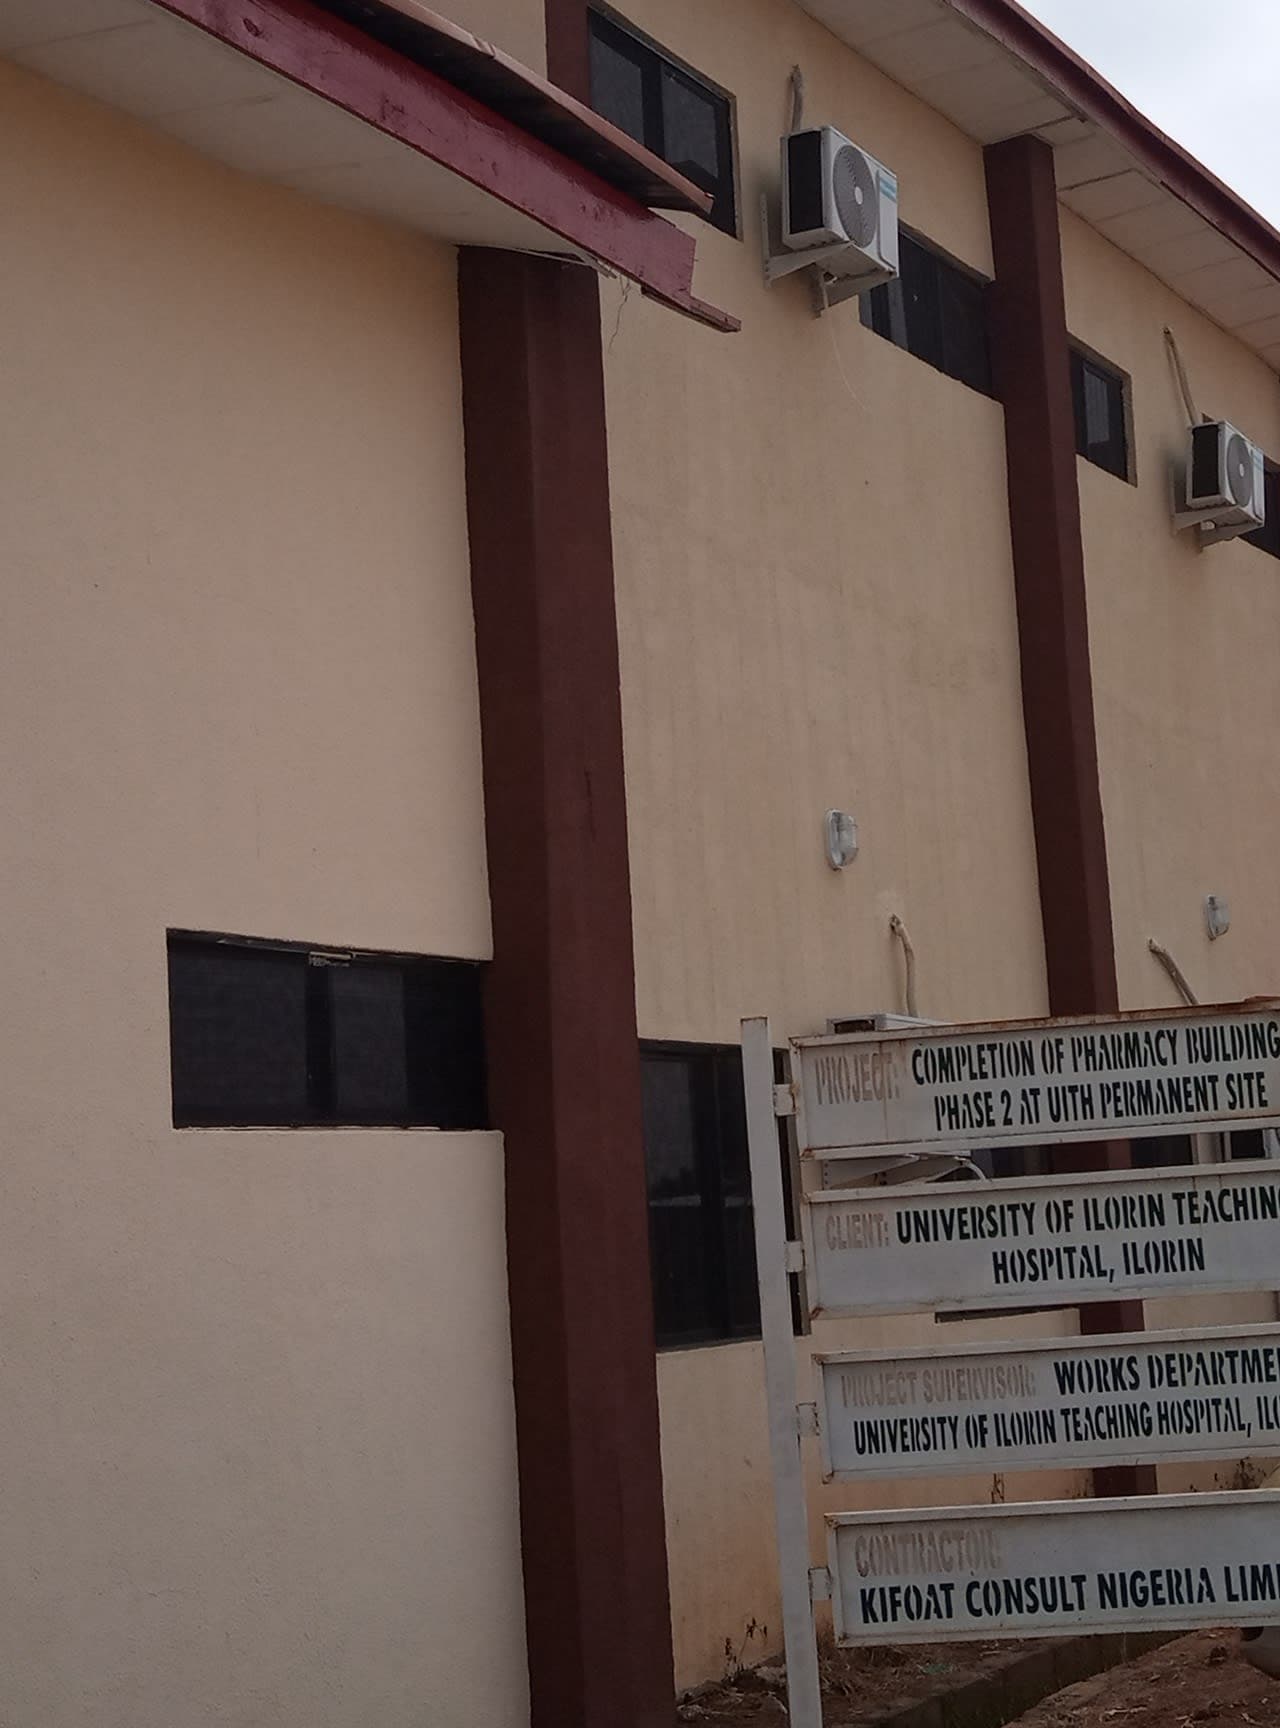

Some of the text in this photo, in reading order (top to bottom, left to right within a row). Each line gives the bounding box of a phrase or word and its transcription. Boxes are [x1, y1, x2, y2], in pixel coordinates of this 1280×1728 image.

[912, 1041, 1035, 1085] COMPLETION
[1041, 1038, 1063, 1074] OF
[1071, 1029, 1177, 1072] PHARMACY
[1186, 1021, 1280, 1064] BUILDING
[934, 1071, 1268, 1131] PHASE 2 AT UITH PERMANENT SITE
[896, 1202, 1035, 1244] UNIVERSITY
[1045, 1199, 1074, 1234] OF
[1083, 1193, 1165, 1231] ILORIN
[992, 1238, 1205, 1284] HOSPITAL, ILORIN
[1053, 1355, 1140, 1395] WORKS
[853, 1415, 958, 1455] UNIVERSITY
[965, 1413, 988, 1449] OF
[994, 1409, 1056, 1447] ILORIN
[1060, 1401, 1152, 1441] TEACHING
[1157, 1397, 1251, 1438] HOSPITAL,
[859, 1582, 954, 1623] KIFOAT
[965, 1574, 1086, 1617] CONSULT
[1097, 1567, 1216, 1609] NIGERIA
